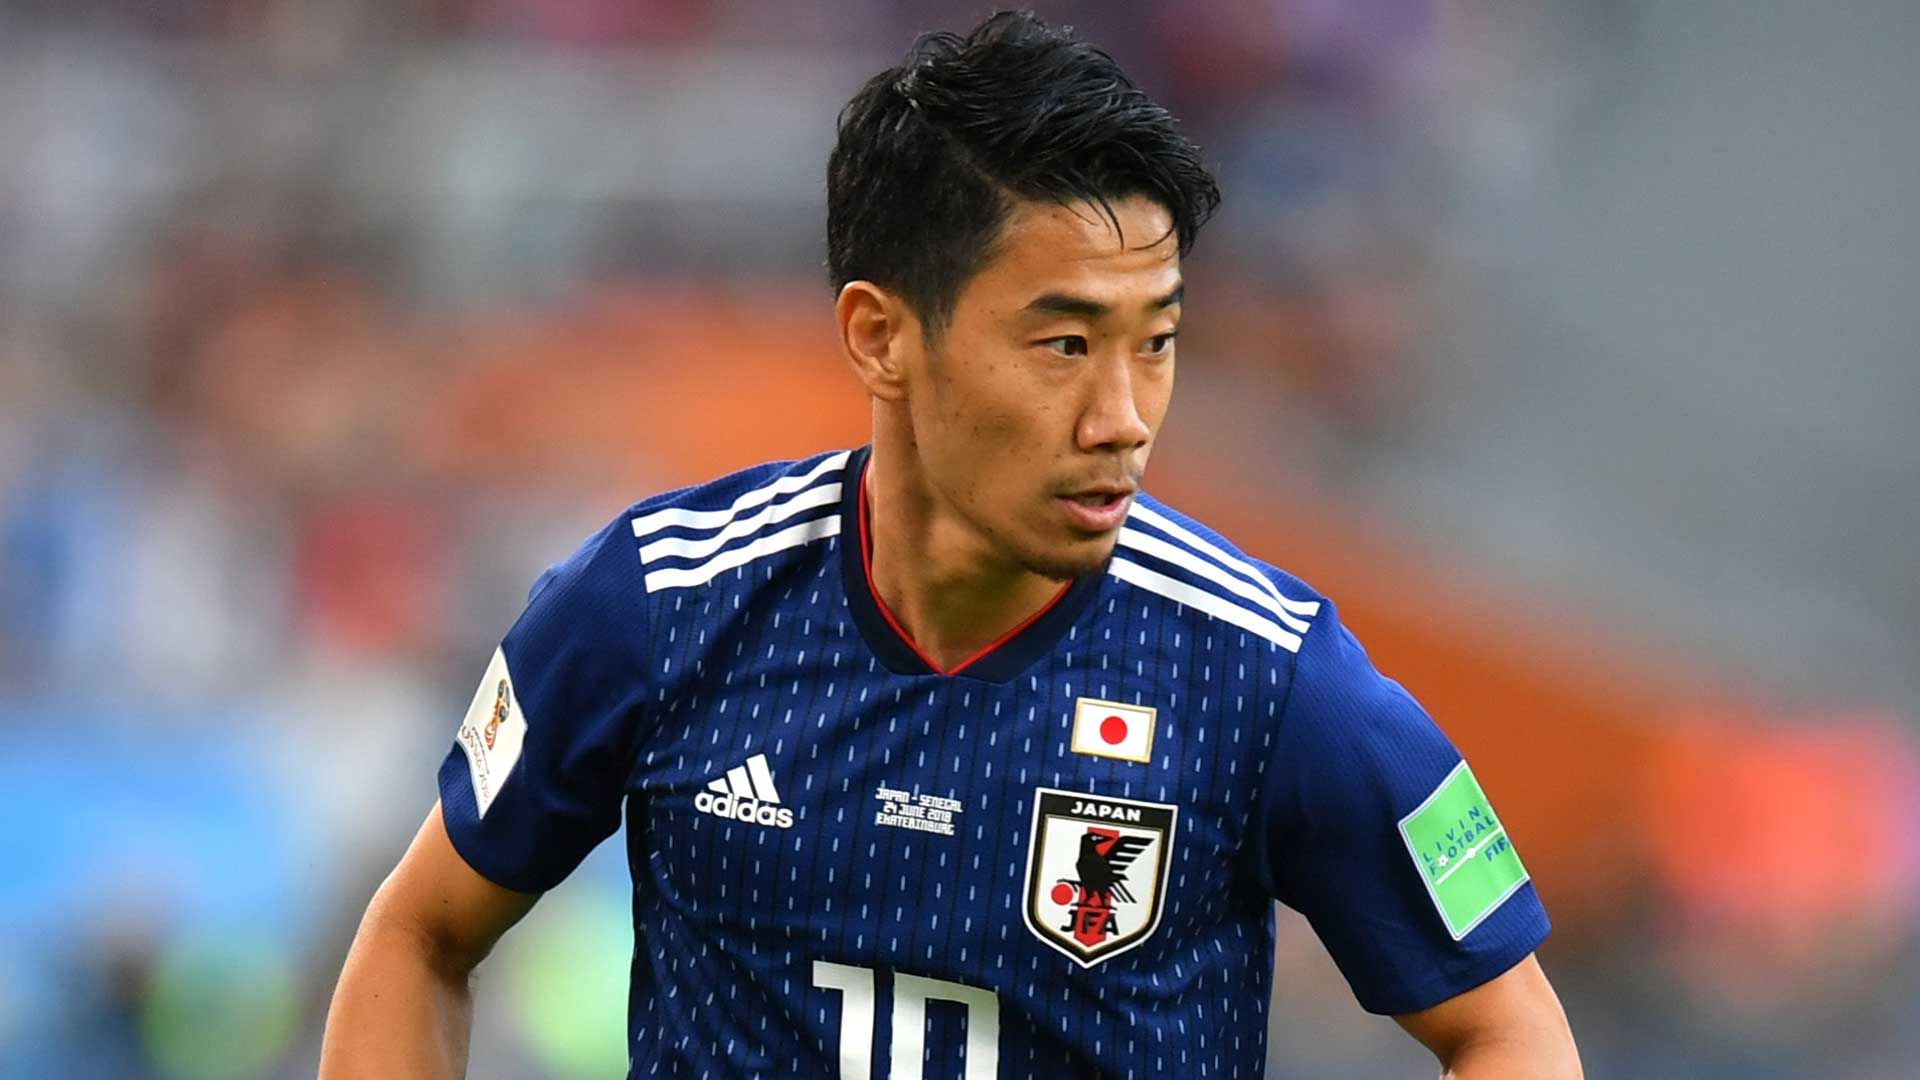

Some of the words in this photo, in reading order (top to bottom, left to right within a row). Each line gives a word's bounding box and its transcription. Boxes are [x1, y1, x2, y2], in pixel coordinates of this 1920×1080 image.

[694, 791, 794, 829] adidas
[875, 787, 910, 803] JAPAN
[918, 794, 963, 813] SENEGAL
[883, 801, 898, 814] 24
[898, 804, 926, 818] JUNE
[927, 808, 953, 823] 2018
[1071, 801, 1141, 822] JAPAN
[875, 812, 955, 836] EKATERINBURG
[1060, 907, 1119, 936] JFA
